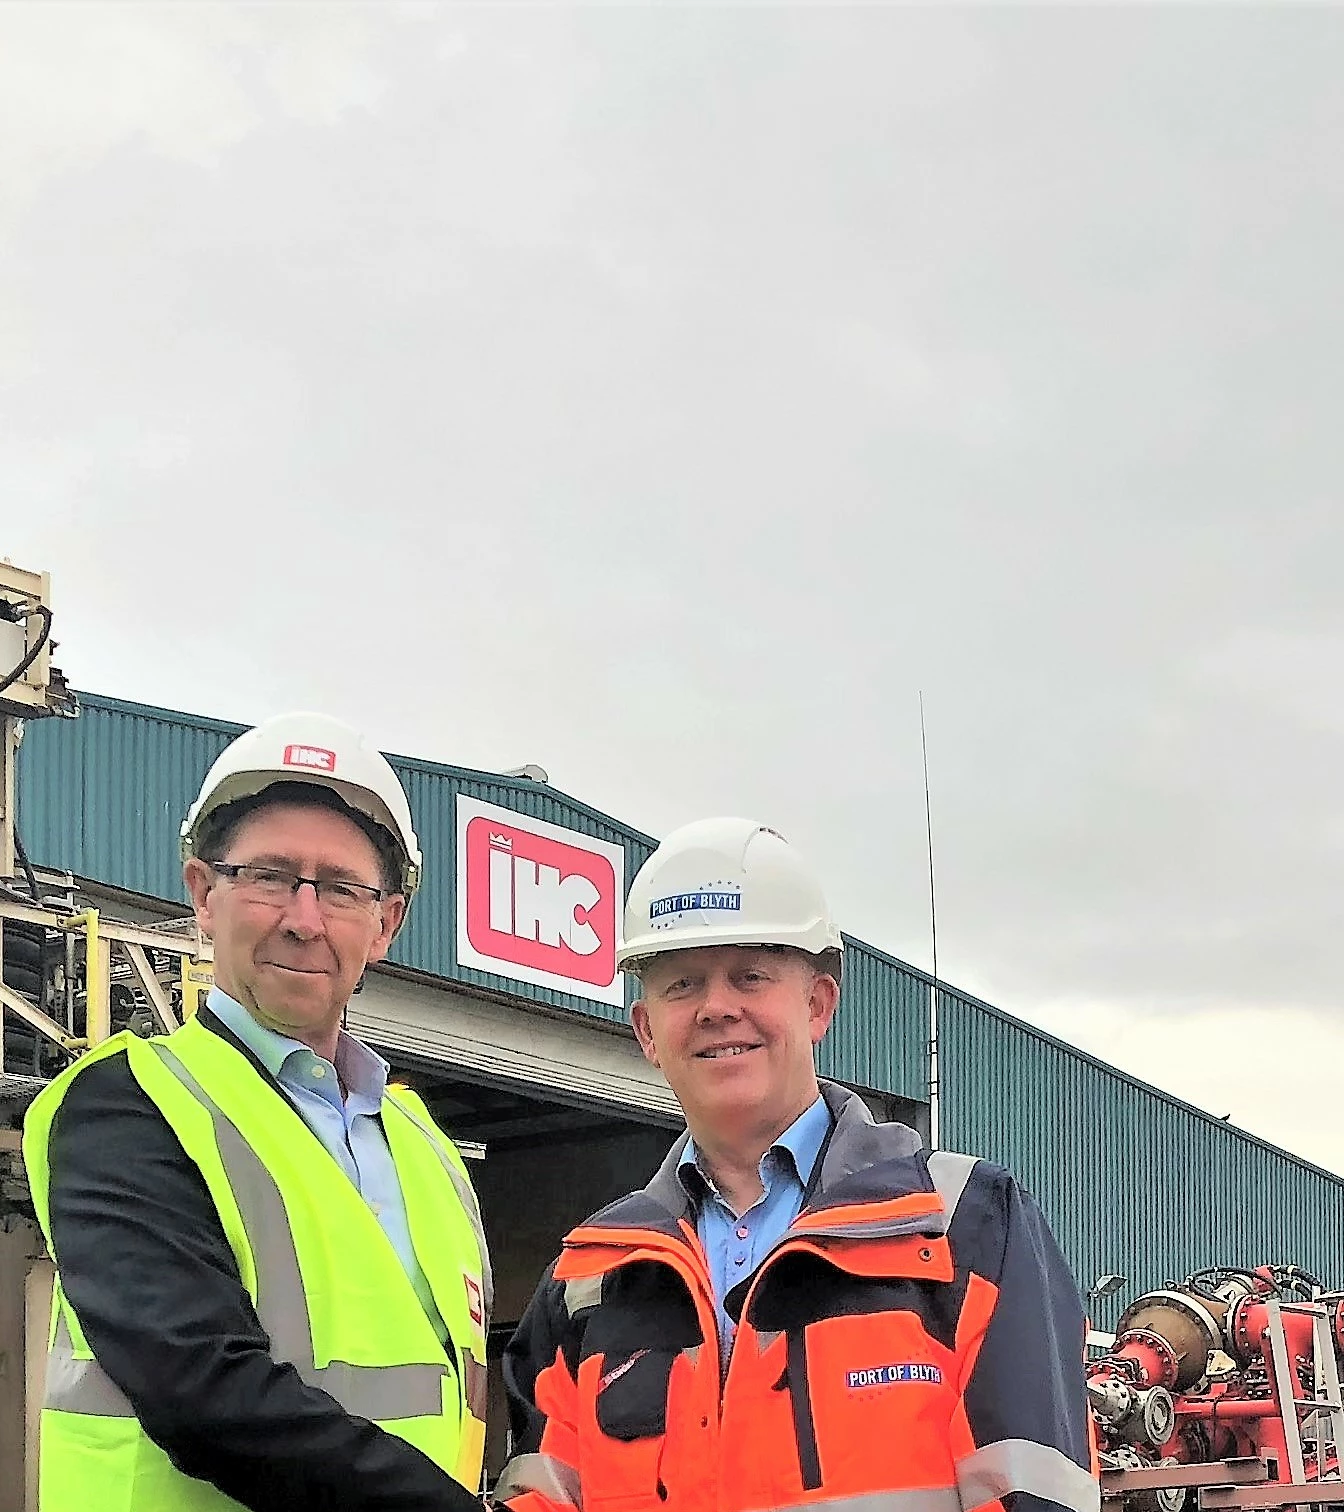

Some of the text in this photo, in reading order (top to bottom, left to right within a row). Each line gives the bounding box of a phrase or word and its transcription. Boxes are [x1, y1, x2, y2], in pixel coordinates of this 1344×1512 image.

[489, 832, 602, 956] IHC
[652, 894, 737, 917] PORT OF BLYTH
[849, 1364, 941, 1387] PORT OF BLYTH
